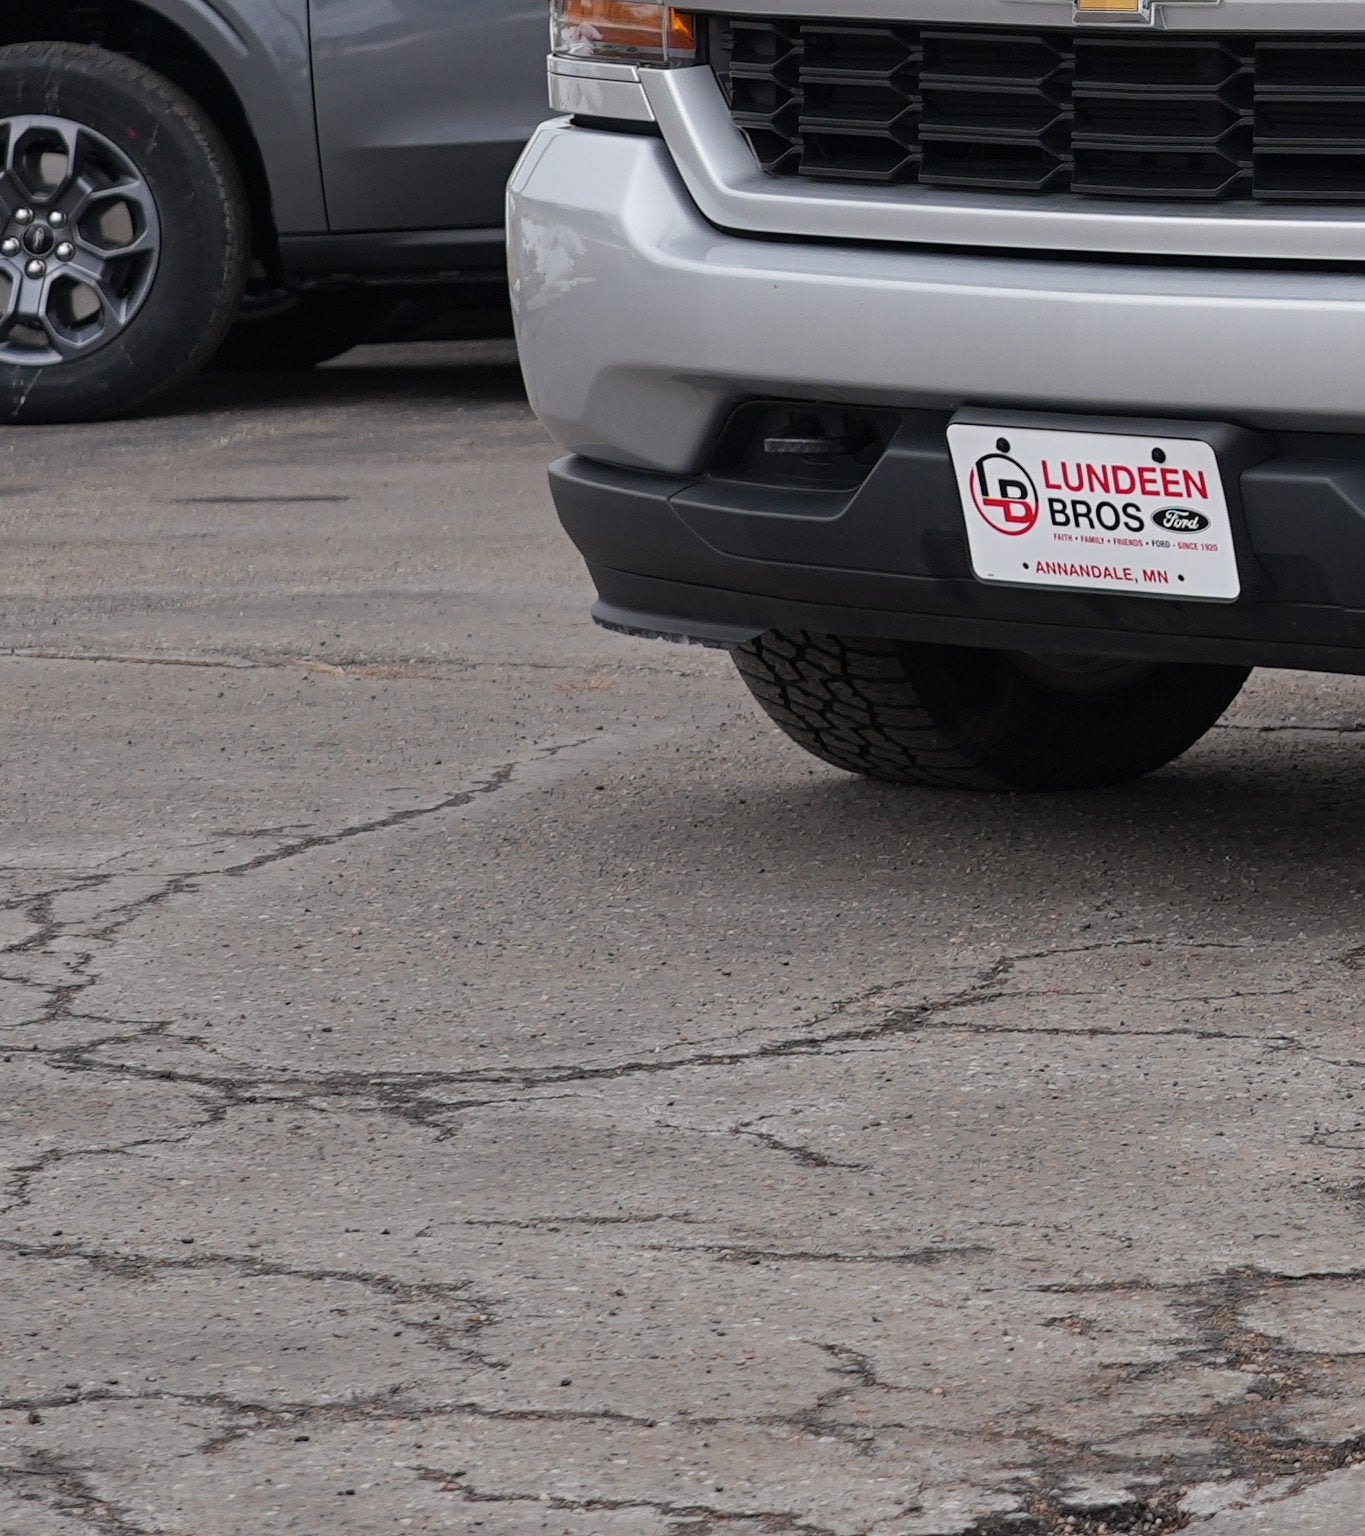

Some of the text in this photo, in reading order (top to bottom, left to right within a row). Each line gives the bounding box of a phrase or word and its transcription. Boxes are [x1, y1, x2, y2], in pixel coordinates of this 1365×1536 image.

[1041, 460, 1209, 499] LUNDEEN
[1047, 497, 1145, 533] BROS
[1053, 533, 1073, 541] FAITH
[1151, 540, 1171, 548] FORD
[1177, 542, 1198, 551] SINCE
[1036, 560, 1169, 584] ANNANDALE, MN
